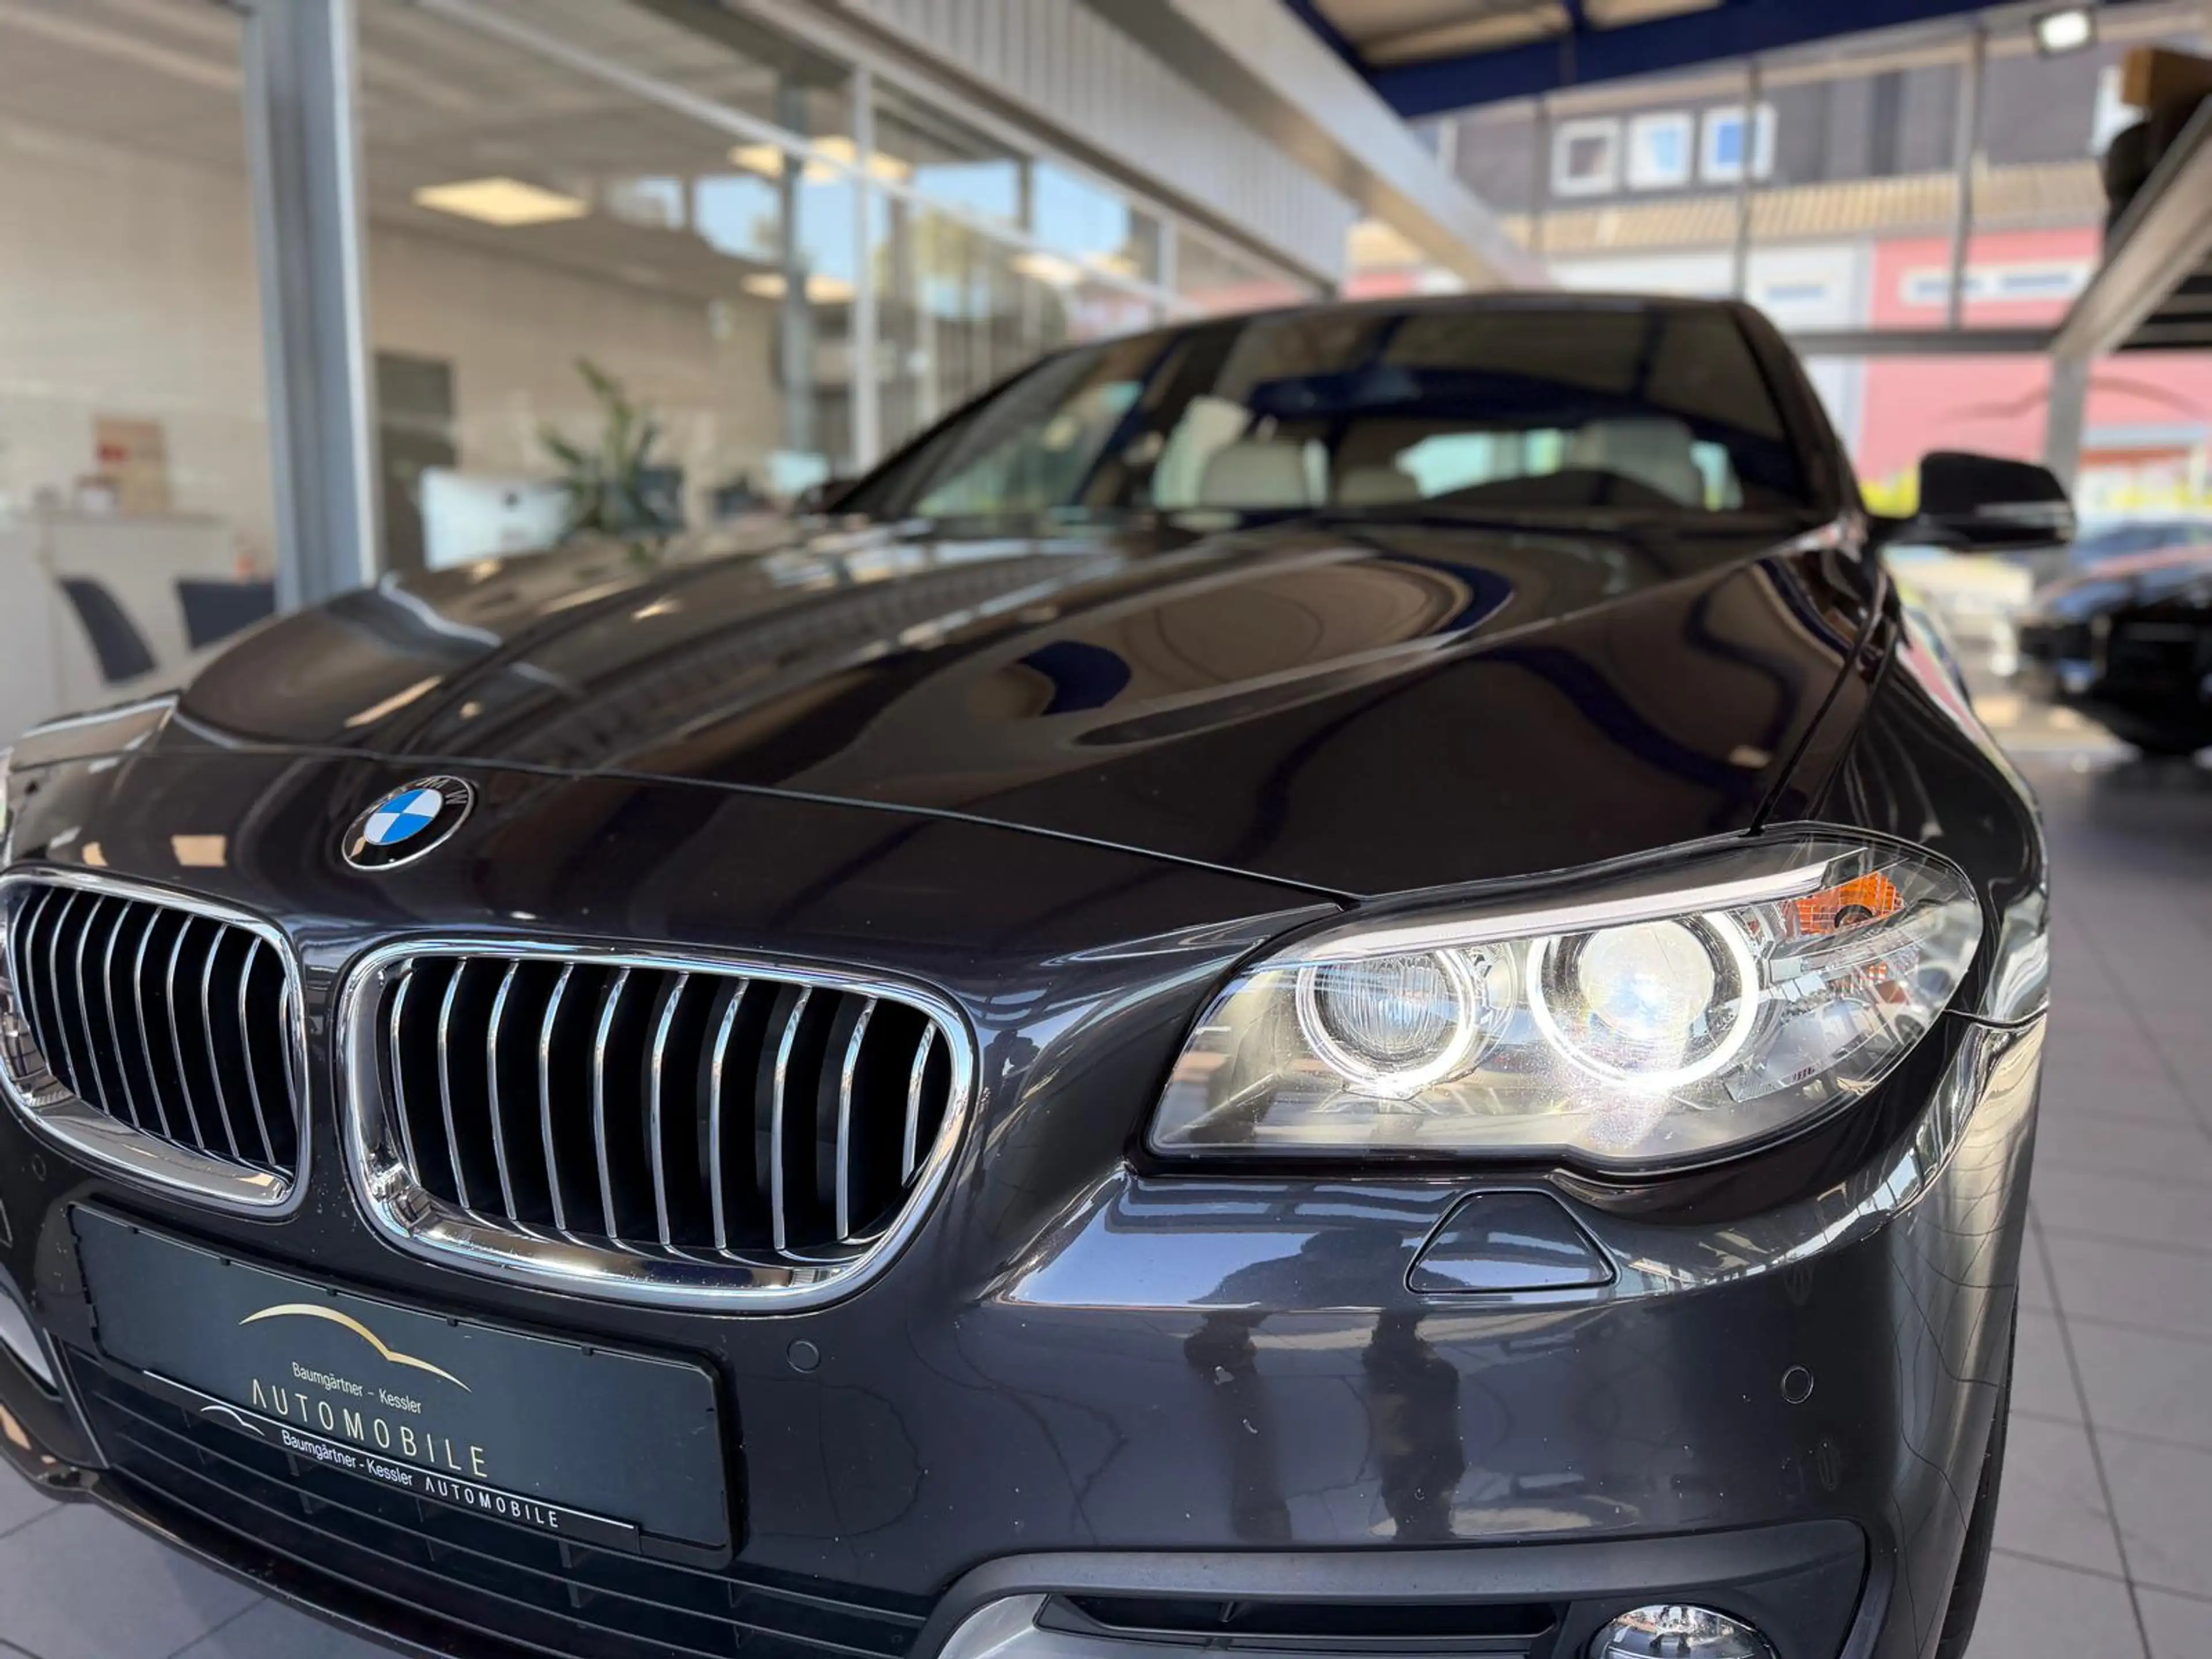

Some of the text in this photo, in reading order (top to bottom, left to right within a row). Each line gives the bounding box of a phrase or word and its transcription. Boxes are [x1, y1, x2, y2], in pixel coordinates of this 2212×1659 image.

[252, 1378, 488, 1478] AUTOMOBILE
[292, 1361, 363, 1397] Baumgärtner
[378, 1388, 422, 1414] Kessler
[281, 1429, 357, 1468] Baumgärtner
[366, 1458, 413, 1486] Kessler
[425, 1476, 559, 1528] AUTOMOBILE
